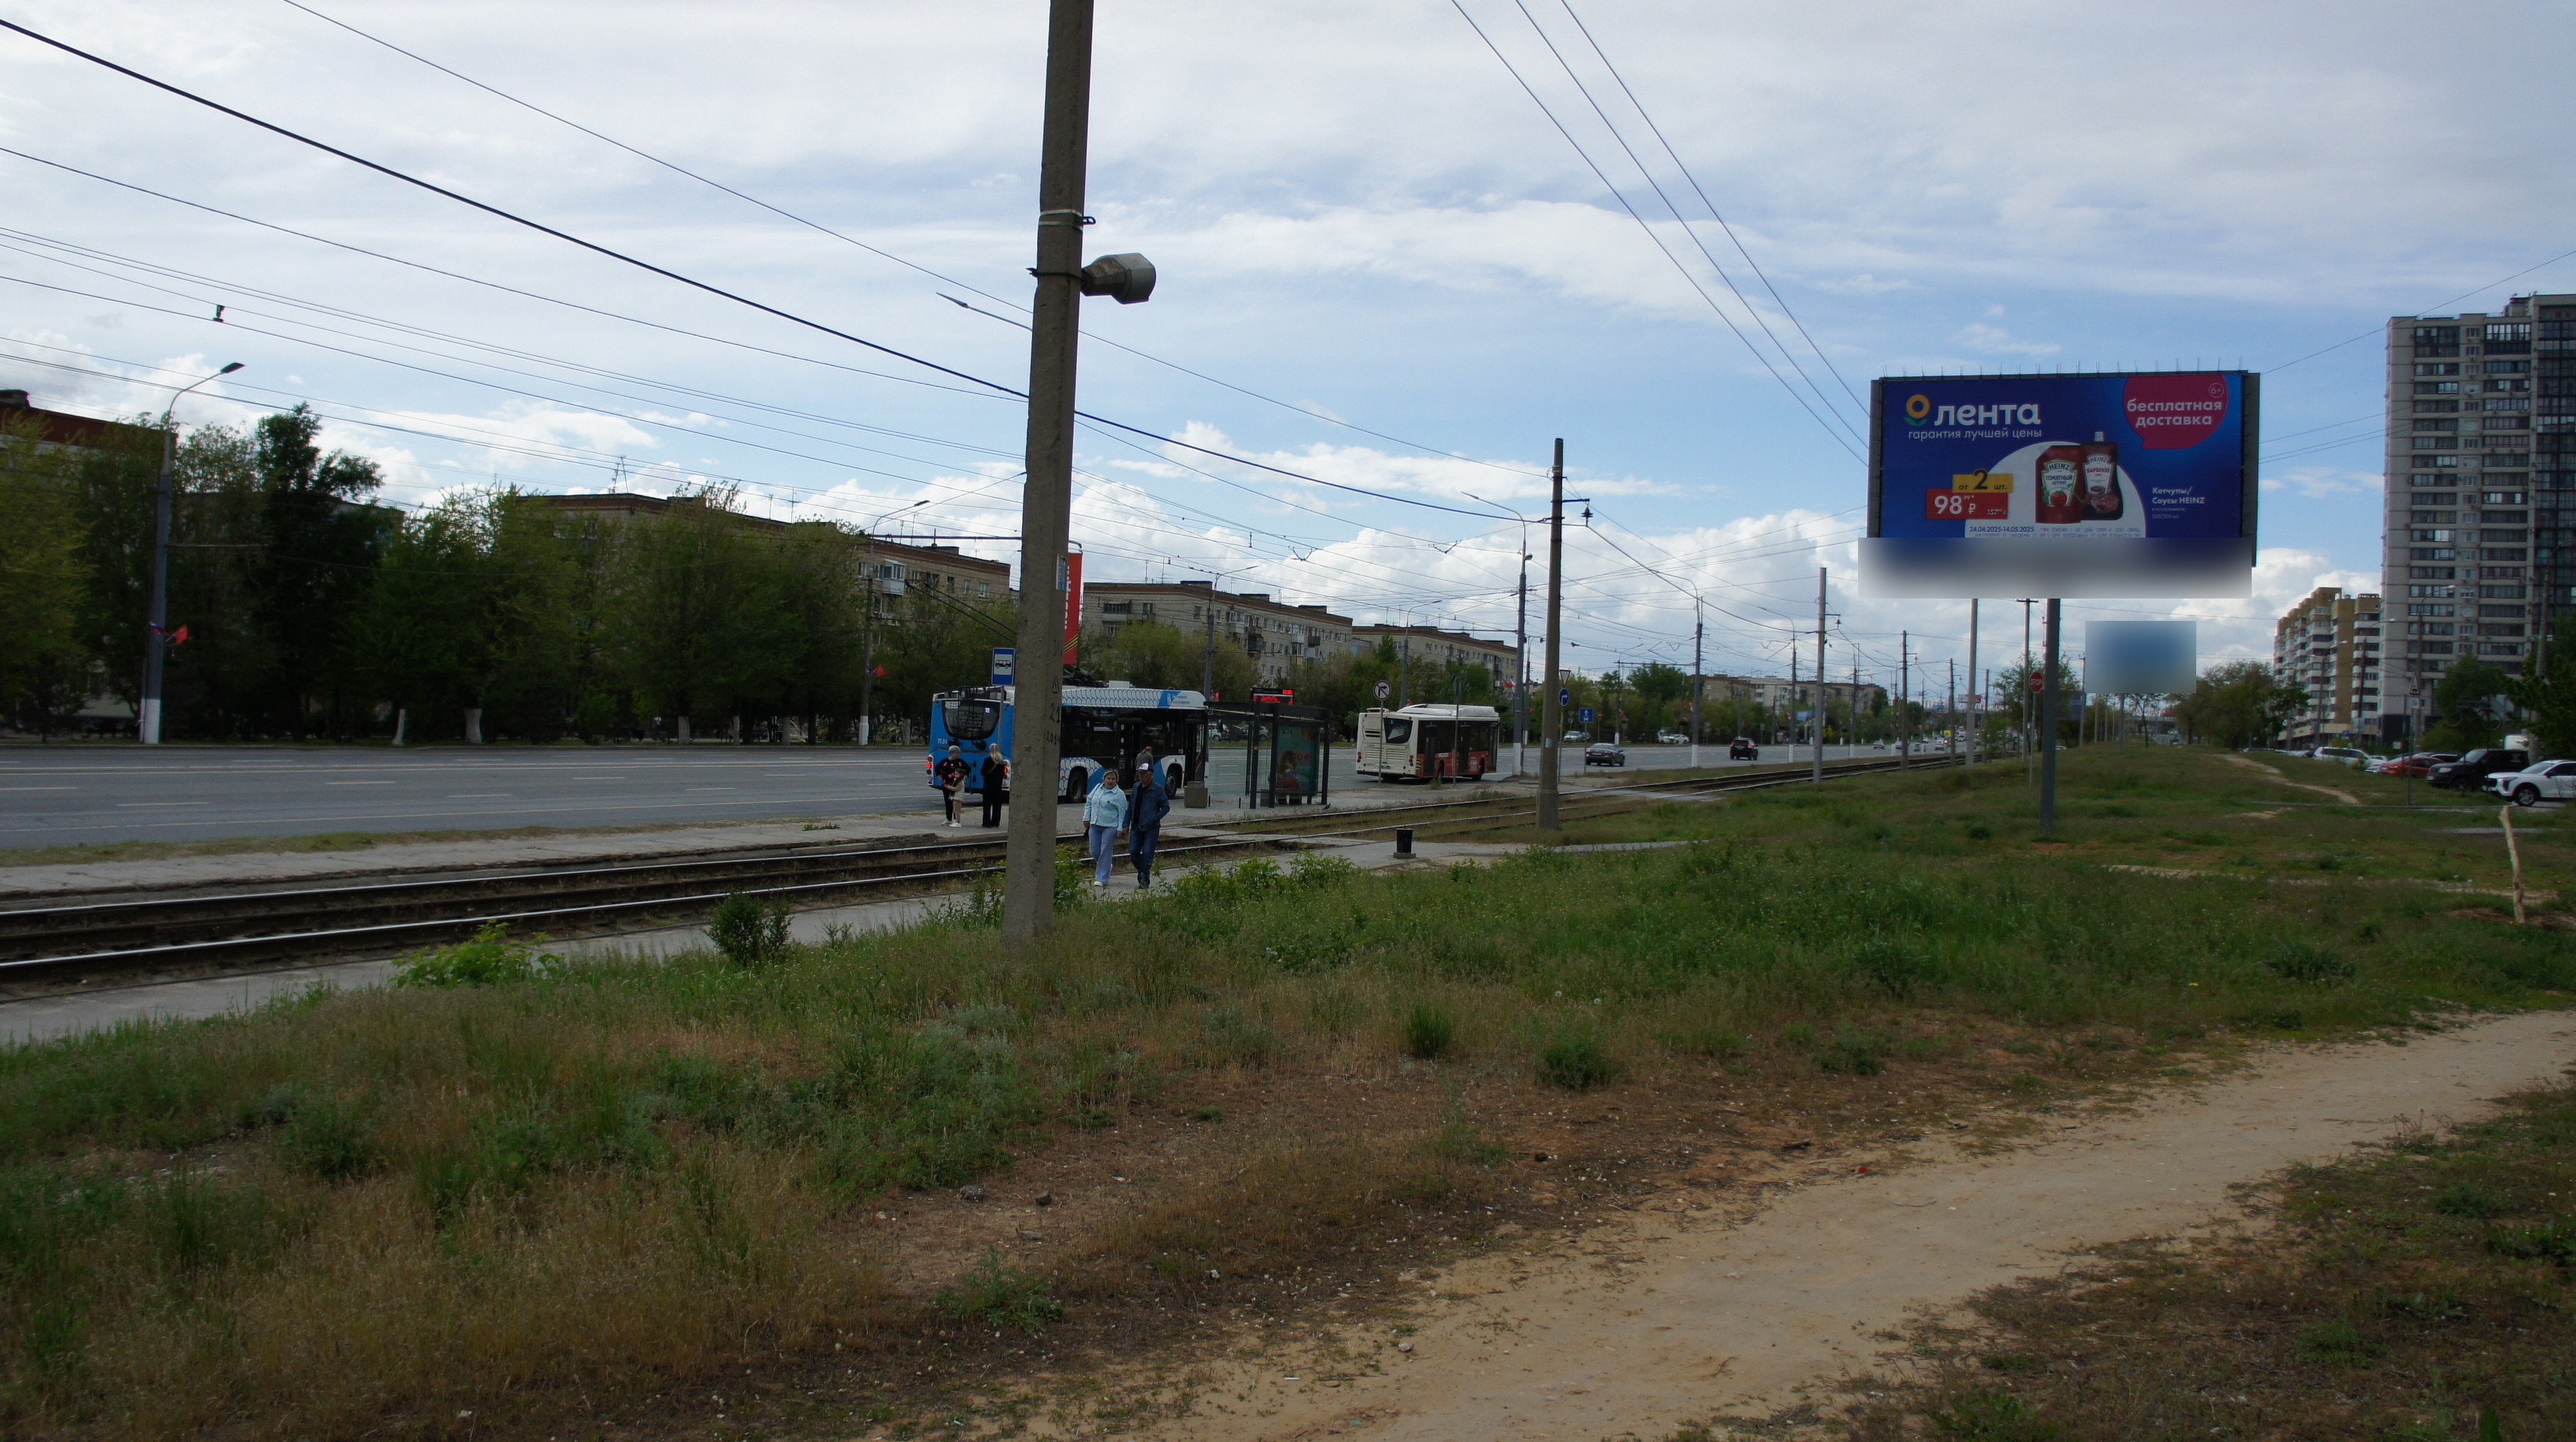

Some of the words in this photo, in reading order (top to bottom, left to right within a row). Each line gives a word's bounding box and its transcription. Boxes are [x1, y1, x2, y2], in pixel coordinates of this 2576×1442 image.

[2127, 397, 2222, 412] бесплатная
[1934, 404, 2041, 426] лента
[2135, 415, 2212, 428] доставка
[1908, 431, 1961, 442] гарантия
[1964, 428, 2008, 441] лучшей
[2012, 429, 2042, 439] цены
[1973, 468, 1988, 490] 2
[2152, 486, 2192, 495] Кетчупы/
[1934, 495, 1963, 515] 98
[2152, 497, 2177, 505] Соусы
[1049, 703, 1061, 723] 21
